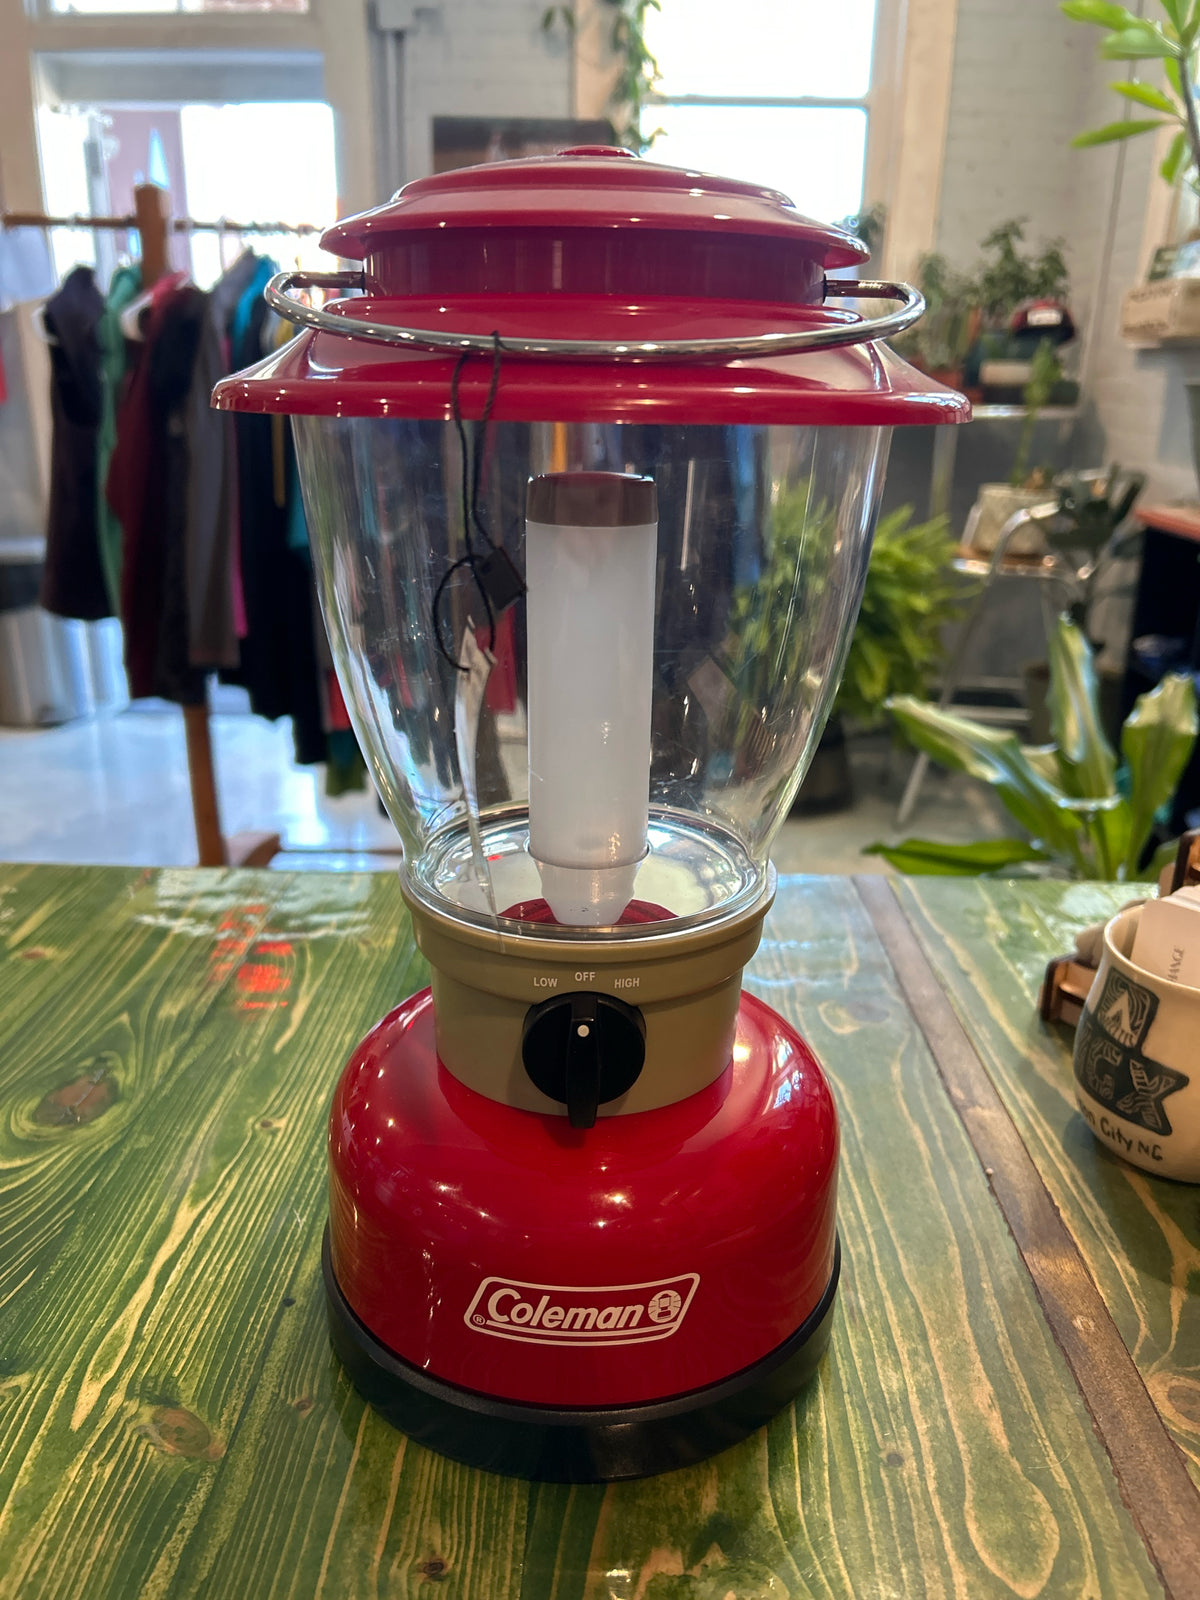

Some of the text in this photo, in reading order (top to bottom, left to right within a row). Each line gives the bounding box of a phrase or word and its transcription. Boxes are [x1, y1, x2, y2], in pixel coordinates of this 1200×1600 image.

[533, 971, 640, 989] LOW OFF HIGH
[1100, 1116, 1133, 1152] City
[487, 1288, 644, 1330] Coleman
